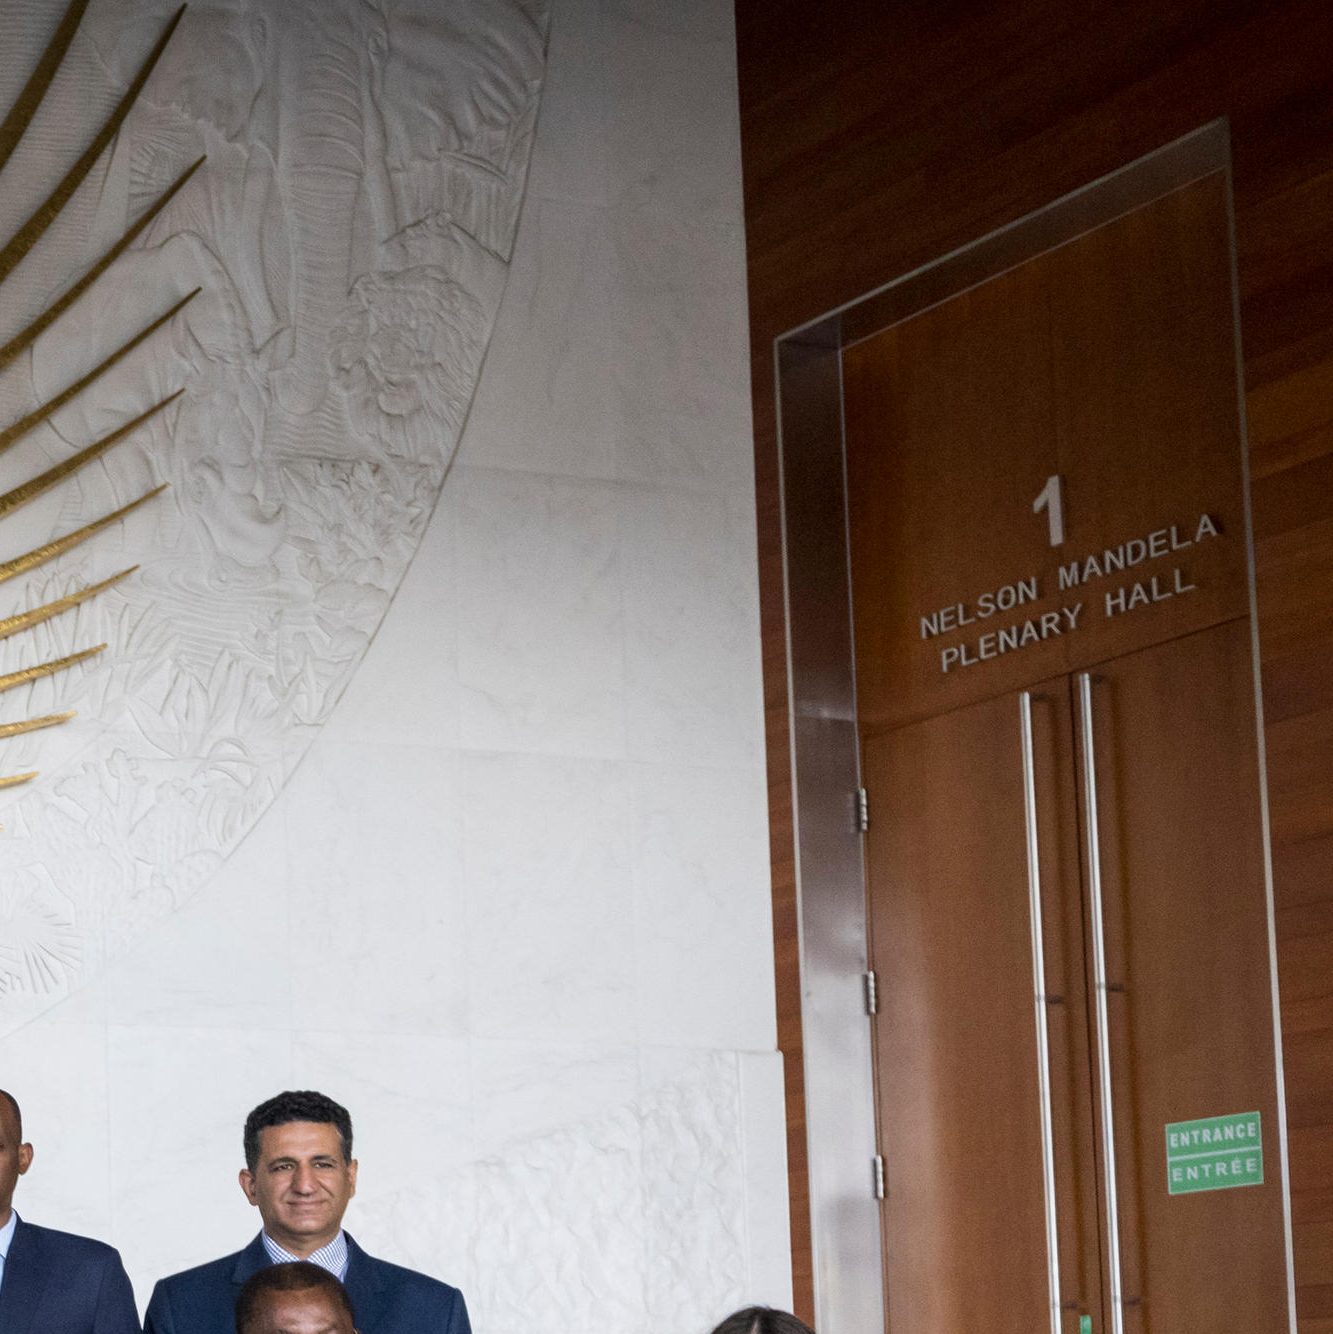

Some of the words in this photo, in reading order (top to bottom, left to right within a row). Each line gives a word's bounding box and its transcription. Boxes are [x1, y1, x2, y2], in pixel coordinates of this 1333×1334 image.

[1032, 474, 1065, 548] 1
[920, 576, 1039, 640] NELSON
[1058, 514, 1218, 590] MANDELA
[941, 603, 1083, 674] PLENARY
[1105, 568, 1197, 618] HALL
[1169, 1122, 1256, 1148] ENTRANCE
[1172, 1157, 1257, 1182] ENTRÉE
